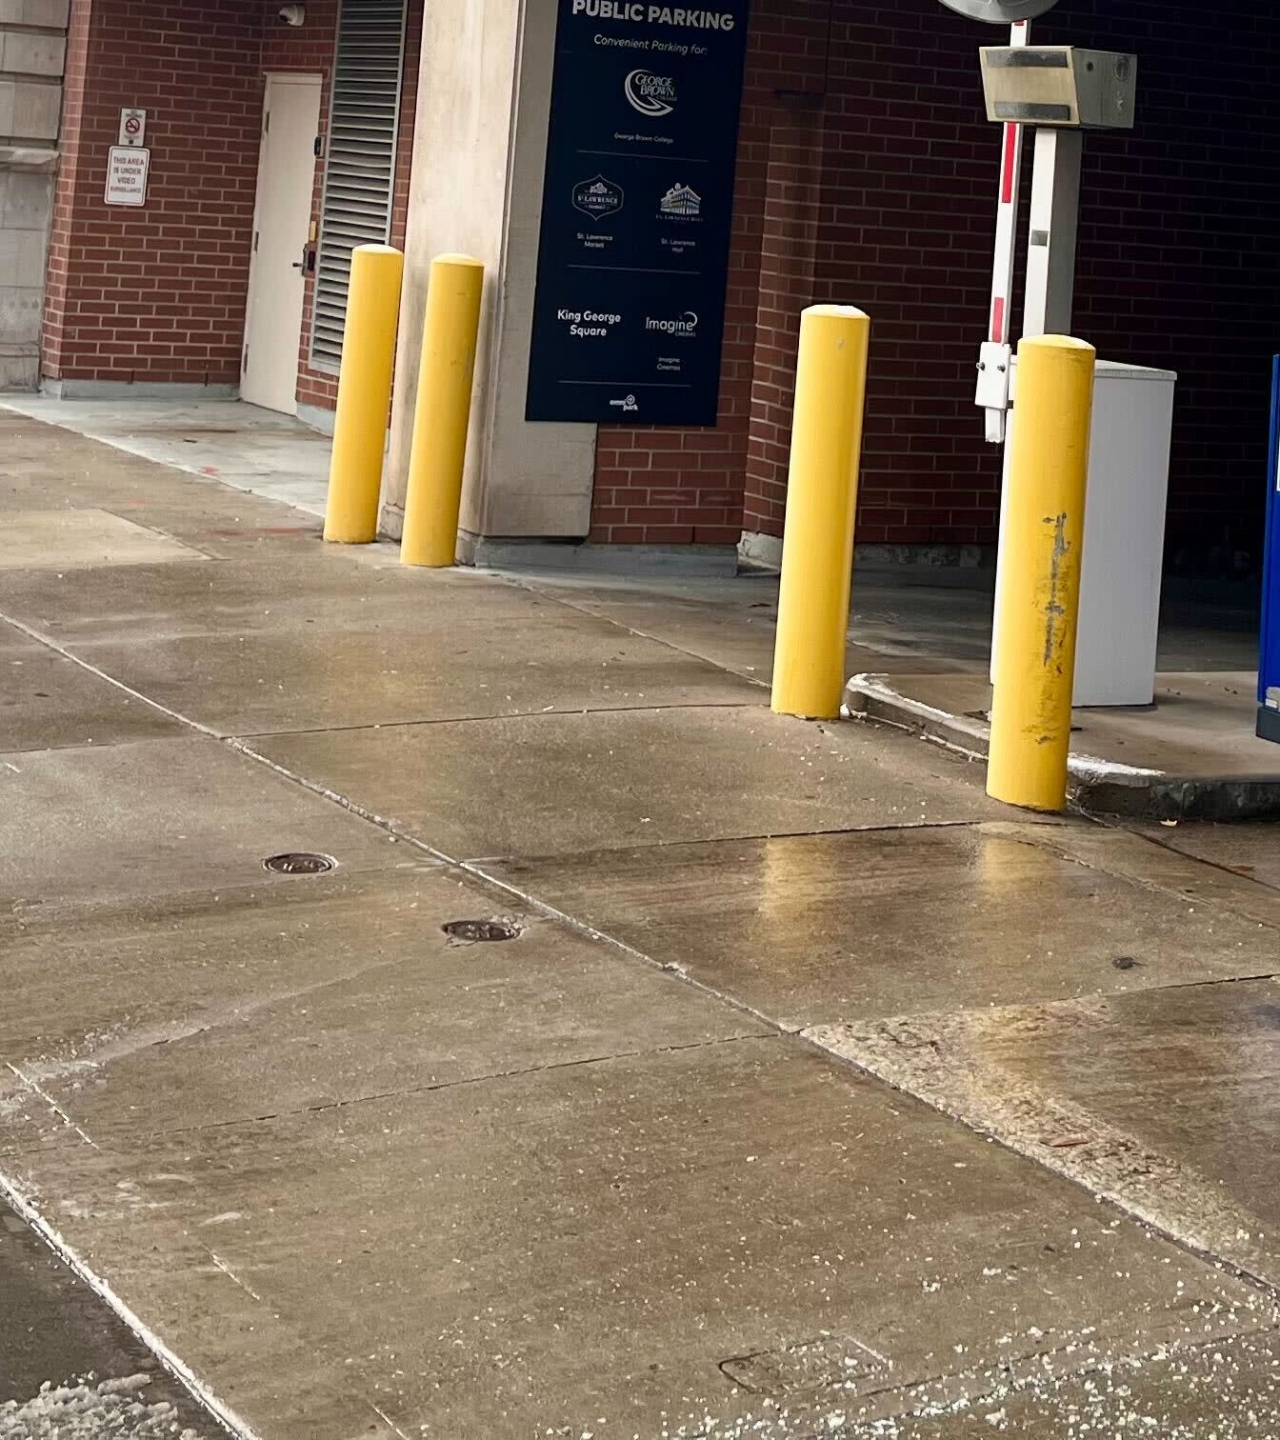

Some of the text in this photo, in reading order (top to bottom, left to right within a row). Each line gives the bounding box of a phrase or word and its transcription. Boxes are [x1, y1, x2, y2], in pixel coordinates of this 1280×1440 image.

[647, 5, 735, 31] PARKING
[593, 34, 708, 56] Convenient Parking for:
[635, 73, 673, 87] GEORGE
[640, 84, 675, 96] BROWN
[113, 156, 145, 166] THIS AREA
[121, 167, 142, 175] UNDER
[117, 176, 136, 185] VIDEO
[557, 309, 622, 325] King George
[645, 314, 697, 334] Imagine
[570, 324, 607, 338] Square
